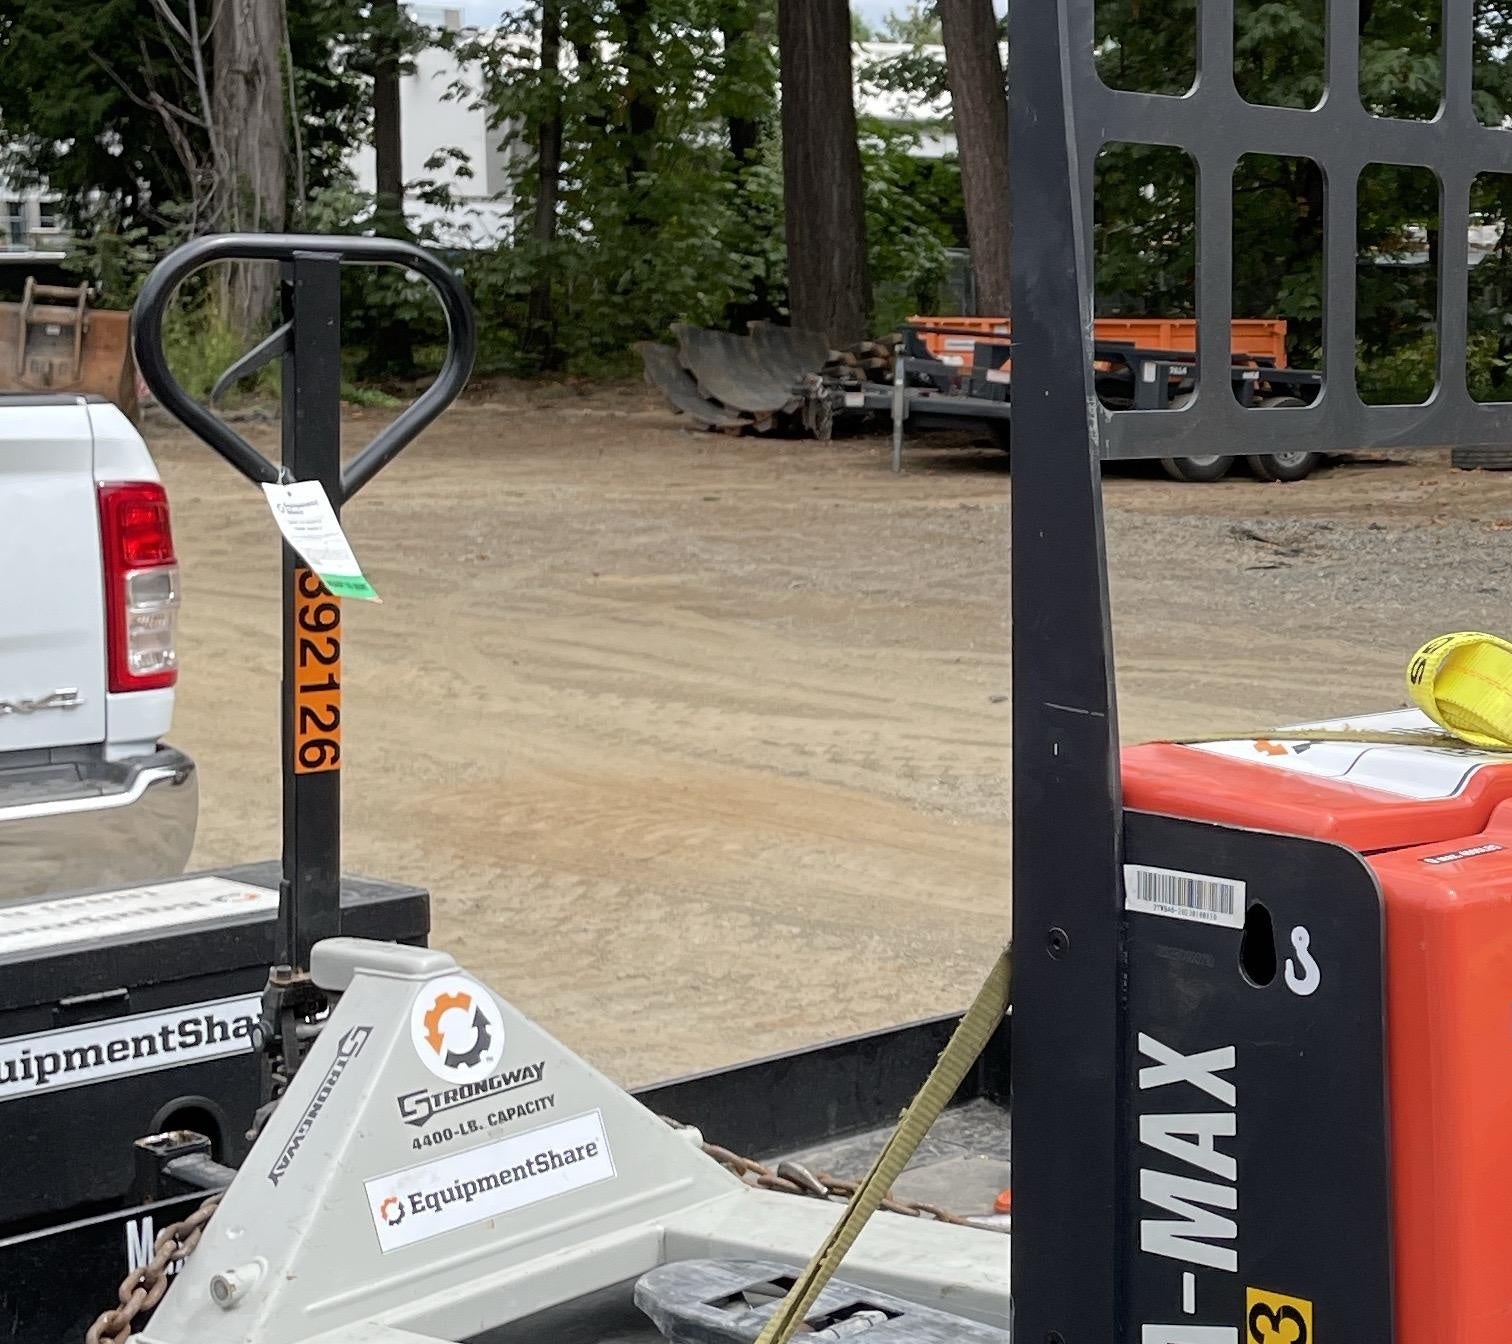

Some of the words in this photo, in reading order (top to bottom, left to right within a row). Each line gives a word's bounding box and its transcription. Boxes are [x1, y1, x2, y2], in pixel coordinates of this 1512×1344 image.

[0, 1014, 263, 1084] uipmentSha
[268, 1026, 374, 1187] STRONGWAY
[397, 1061, 545, 1127] STRONGWAY
[412, 1120, 484, 1150] 4400-LB.
[487, 1094, 556, 1126] CAPACITY
[408, 1141, 599, 1216] EquipmentShare
